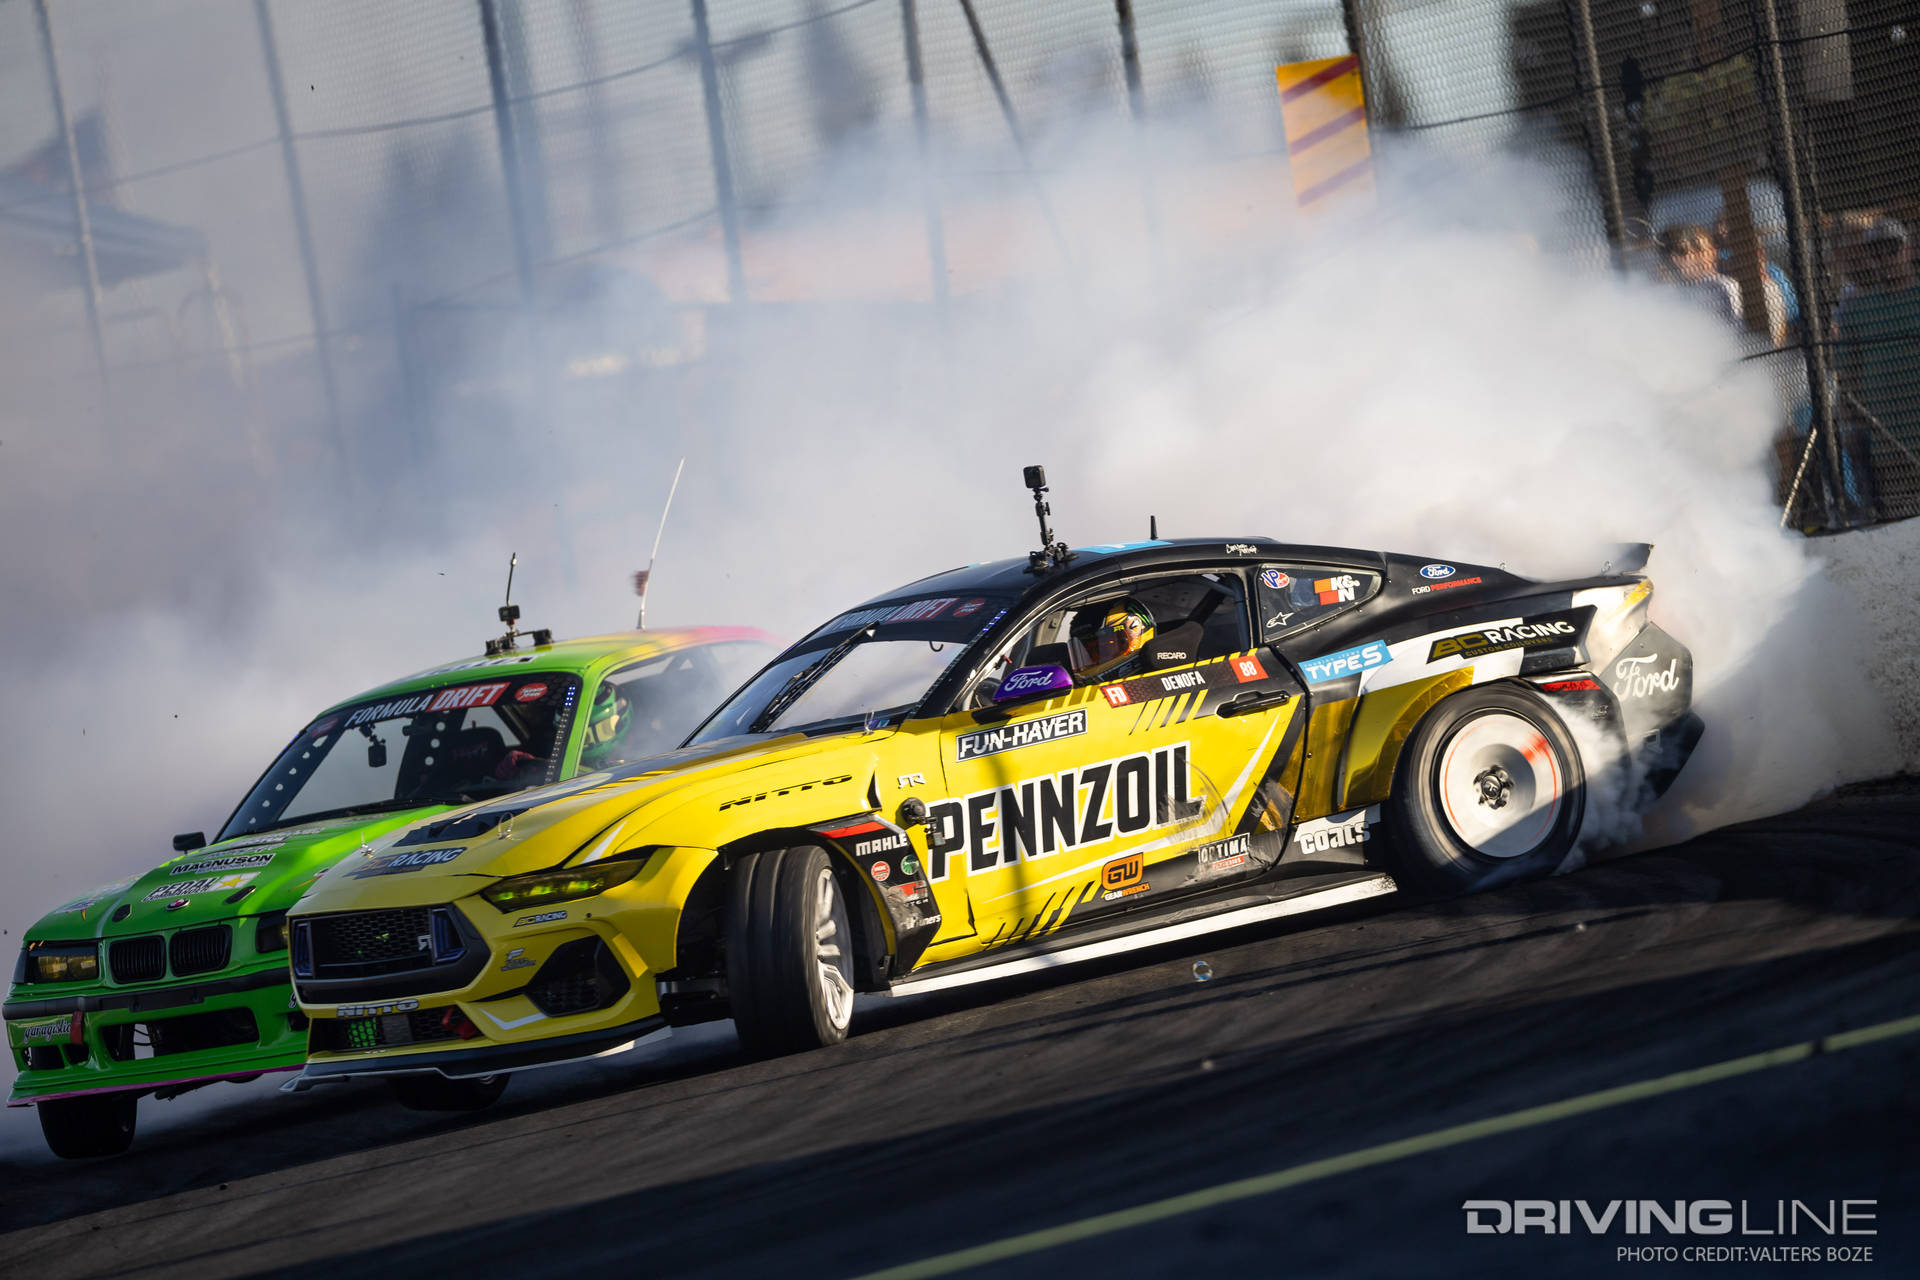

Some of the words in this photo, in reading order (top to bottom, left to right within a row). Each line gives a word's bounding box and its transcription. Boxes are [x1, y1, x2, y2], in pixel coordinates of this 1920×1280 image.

[1427, 565, 1450, 577] Ford
[1412, 585, 1430, 595] FORD
[1430, 577, 1482, 591] PERFORMANCE
[1484, 621, 1576, 643] RACING
[1156, 652, 1187, 660] RECARO
[1238, 660, 1258, 677] 88
[1613, 653, 1680, 700] Ford
[1003, 670, 1054, 692] Ford
[1161, 671, 1205, 691] DENOFA
[344, 694, 435, 728] FORMULA
[430, 684, 506, 711] DRIFT
[1105, 687, 1128, 705] FD
[959, 711, 1085, 757] FUN-HAVER
[719, 774, 852, 812] NITTO
[927, 741, 1206, 883] PENNZOIL
[856, 833, 908, 857] MAHLE
[1300, 820, 1371, 855] coats
[388, 848, 464, 868] RACING
[1201, 836, 1248, 863] OPTIMA
[172, 854, 274, 875] MAGNUSON
[151, 877, 219, 895] PEDAL
[337, 999, 419, 1017] NITTO
